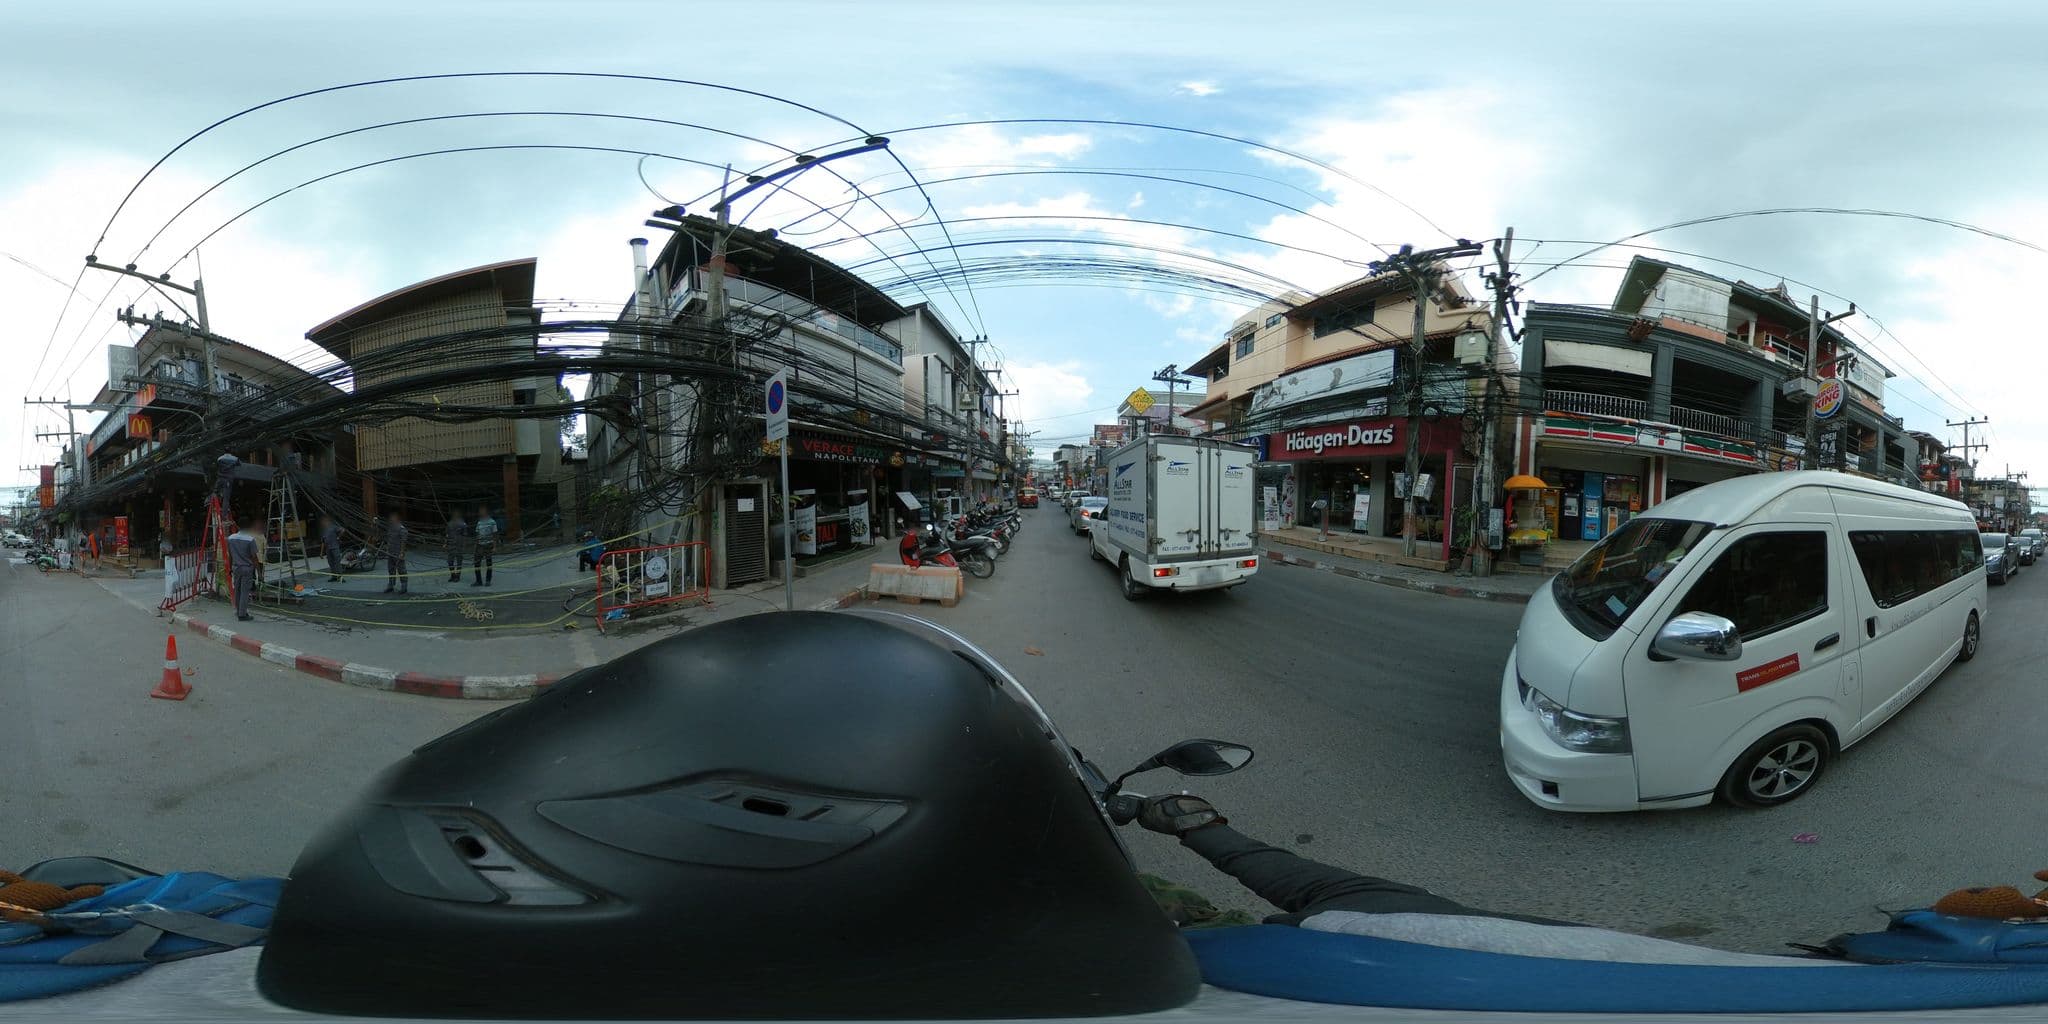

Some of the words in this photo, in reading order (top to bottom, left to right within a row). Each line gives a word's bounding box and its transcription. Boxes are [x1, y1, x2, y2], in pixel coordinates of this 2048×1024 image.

[1814, 390, 1840, 409] KING
[802, 440, 854, 456] VERACE
[856, 446, 884, 460] PIZZA
[814, 452, 880, 464] NAPOLETANA
